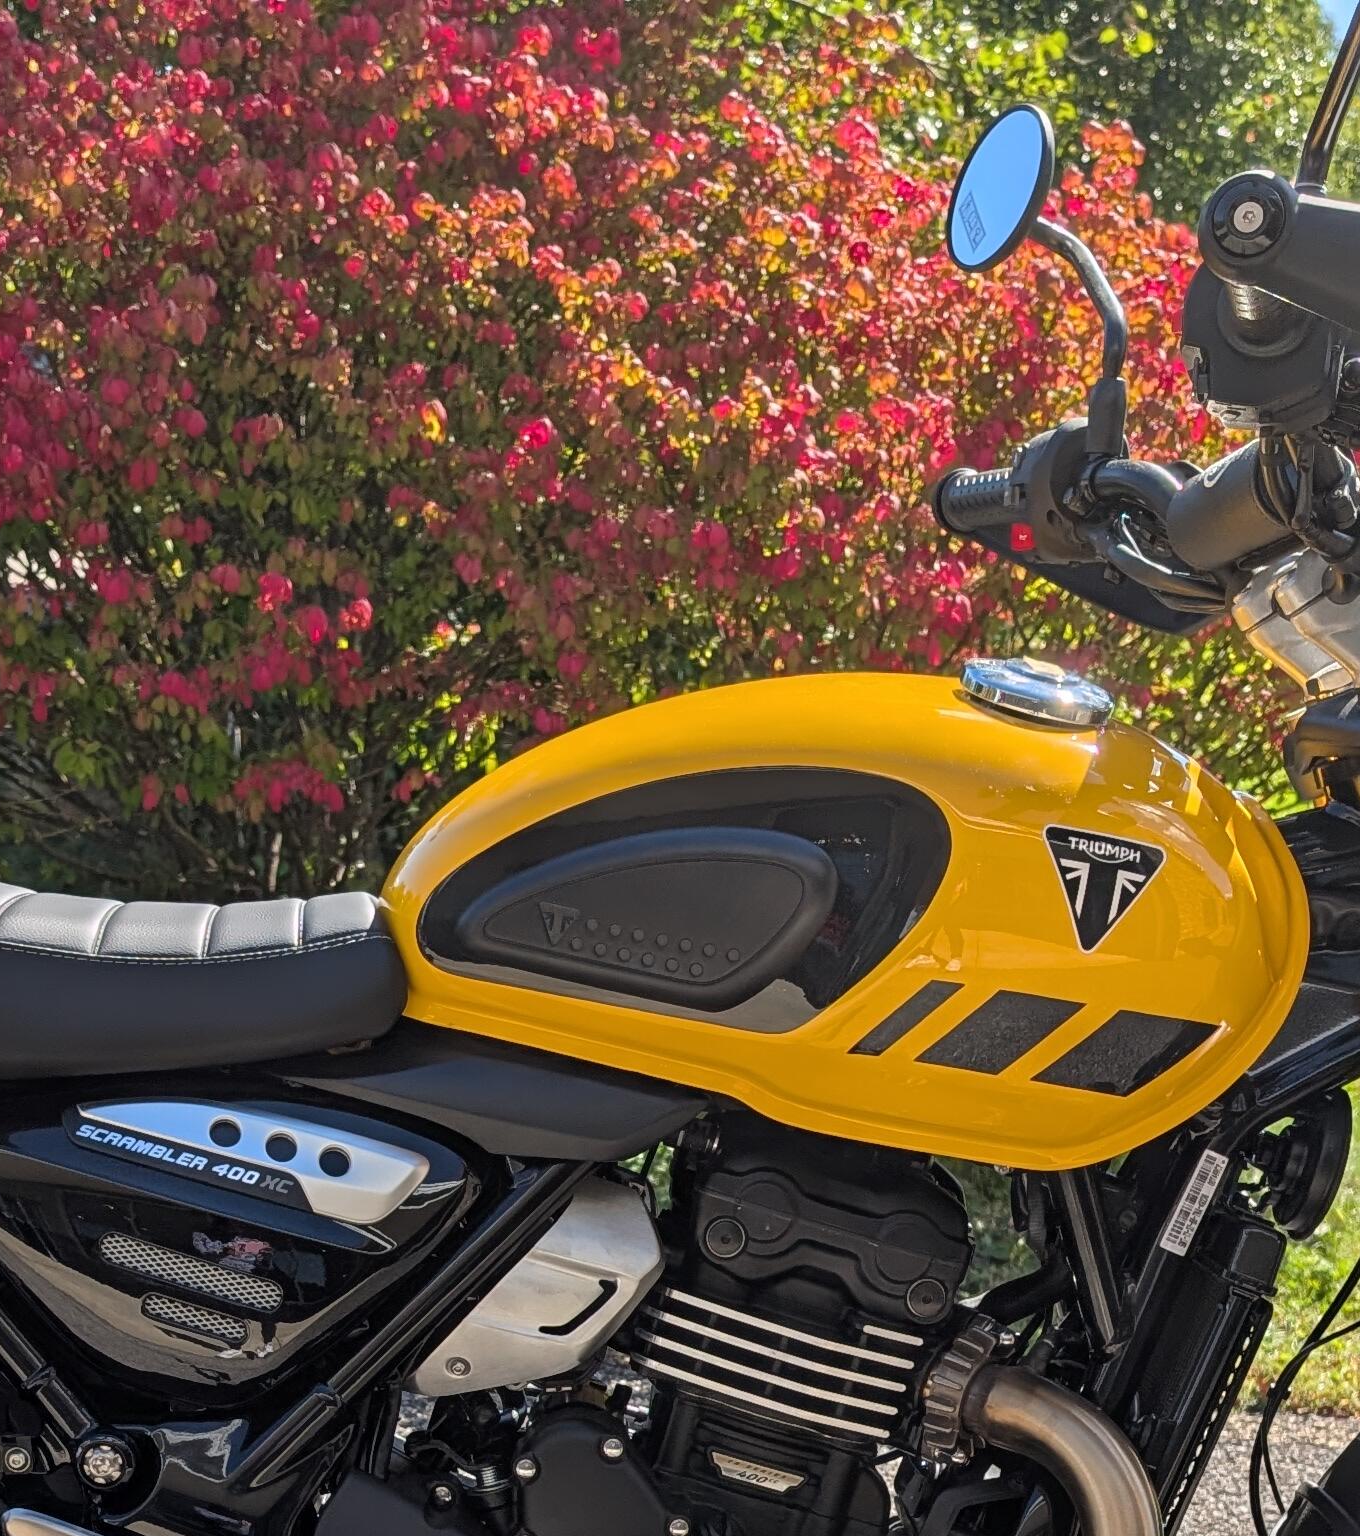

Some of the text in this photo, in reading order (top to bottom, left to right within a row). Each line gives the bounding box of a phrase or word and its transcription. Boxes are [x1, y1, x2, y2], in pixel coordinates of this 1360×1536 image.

[1068, 837, 1141, 864] TRIUMPH
[75, 1124, 295, 1194] SCRAMBLER 400 XC
